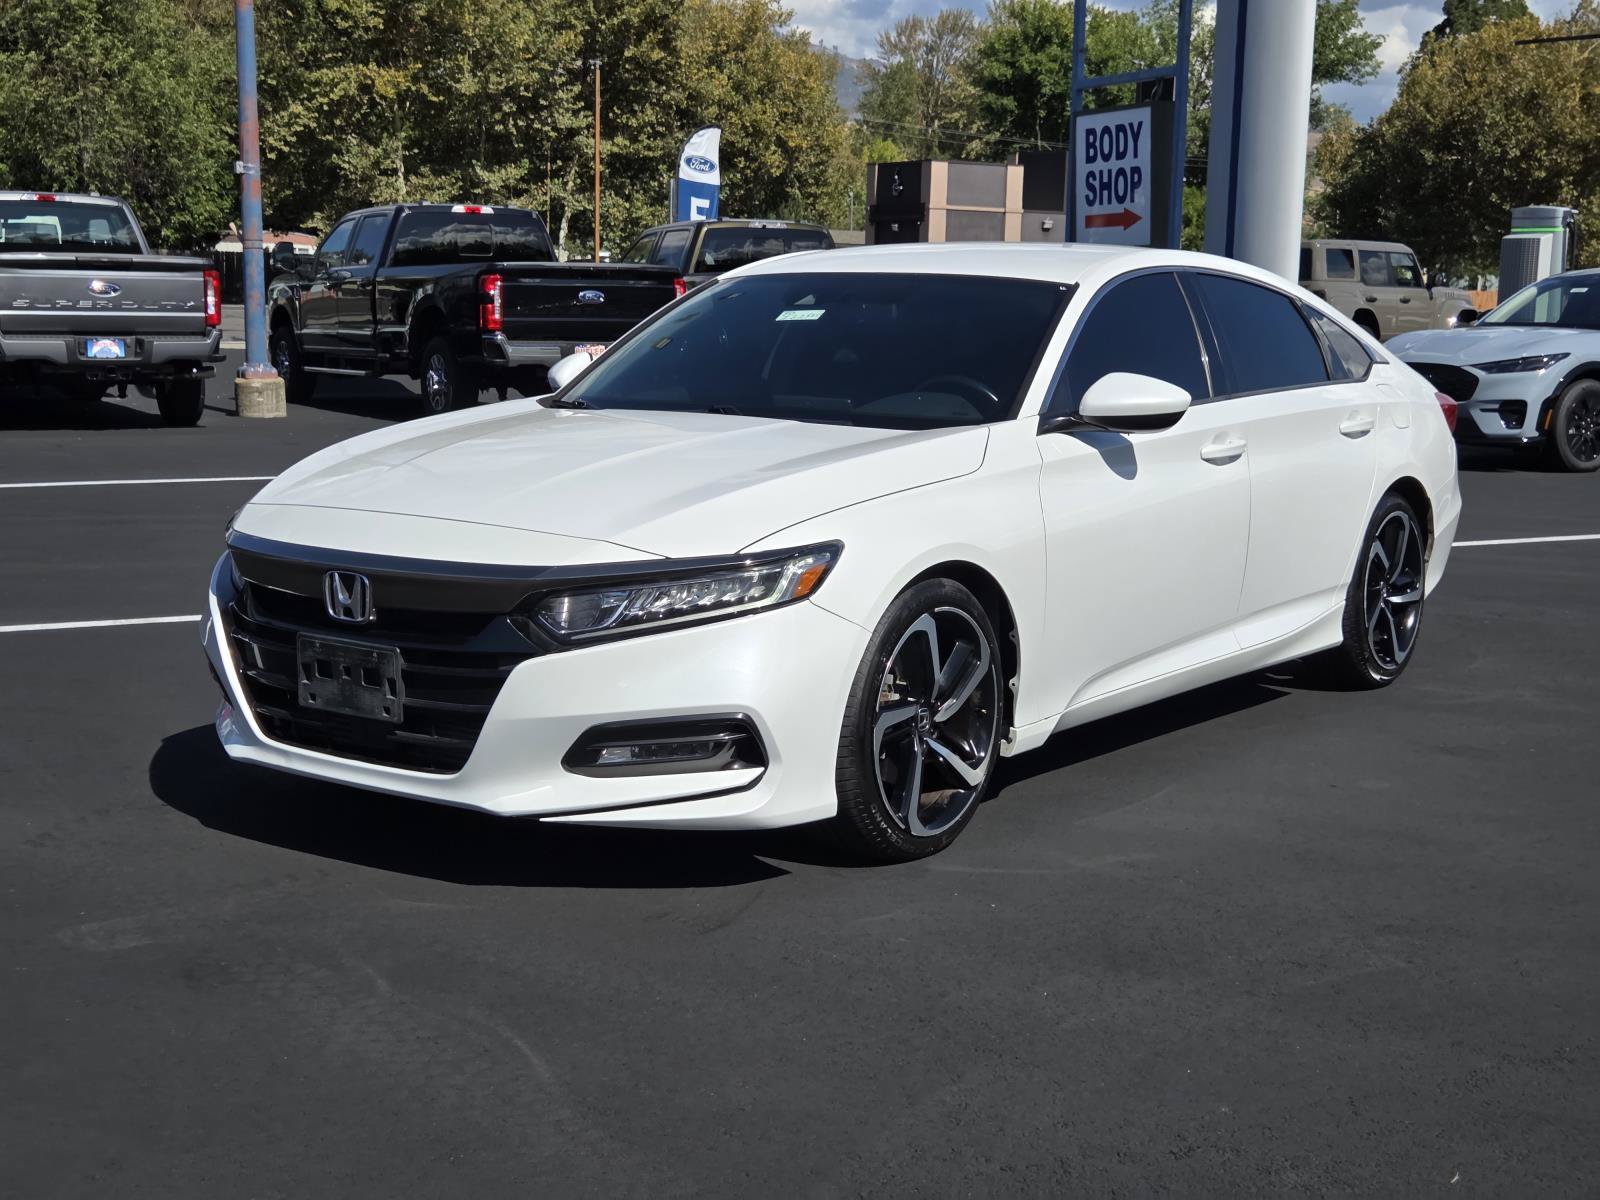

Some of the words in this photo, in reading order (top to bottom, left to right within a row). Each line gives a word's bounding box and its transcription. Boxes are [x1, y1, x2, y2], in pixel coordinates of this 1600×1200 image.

[1085, 121, 1143, 164] BODY
[690, 159, 711, 172] Ford
[1085, 166, 1143, 207] SHOP
